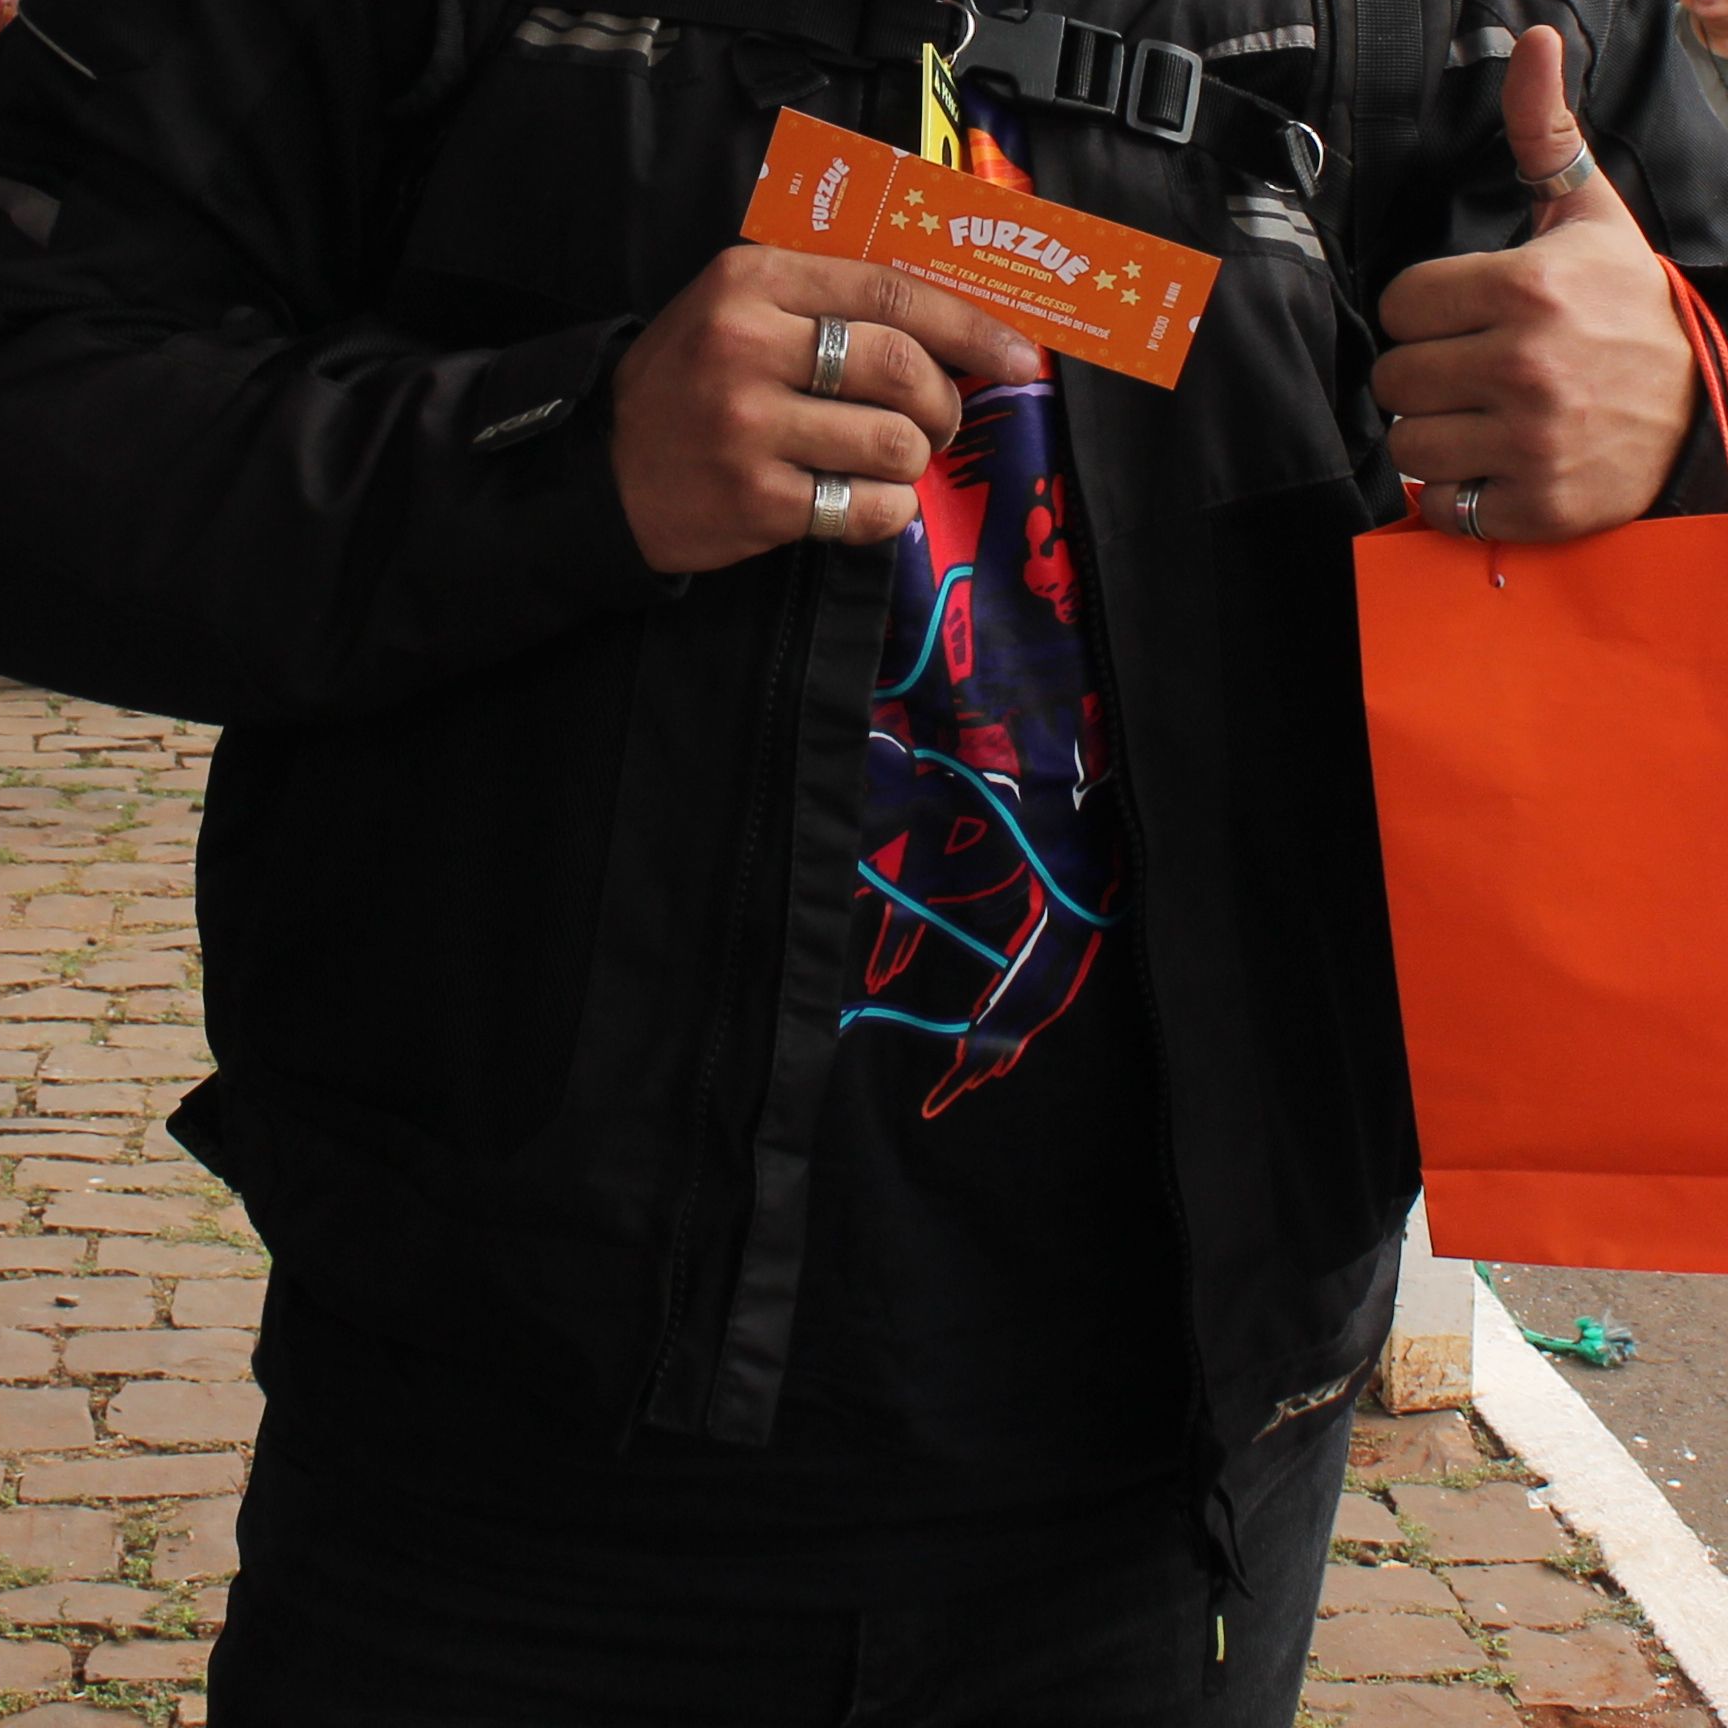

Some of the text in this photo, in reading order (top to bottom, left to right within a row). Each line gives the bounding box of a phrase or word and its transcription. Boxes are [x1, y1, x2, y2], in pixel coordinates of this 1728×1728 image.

[812, 157, 850, 231] FURZUÊ
[930, 258, 1077, 314] VOCÊ TEM A CHAVE DE ACESSO!
[949, 215, 1091, 286] FURZUÊ
[973, 249, 1053, 283] ALPHA EDITION
[892, 257, 1111, 340] VALE UMA ENTRADA GRATUITA PARA A PRÓXIMA EDIÇÃO DO FURZUÊ
